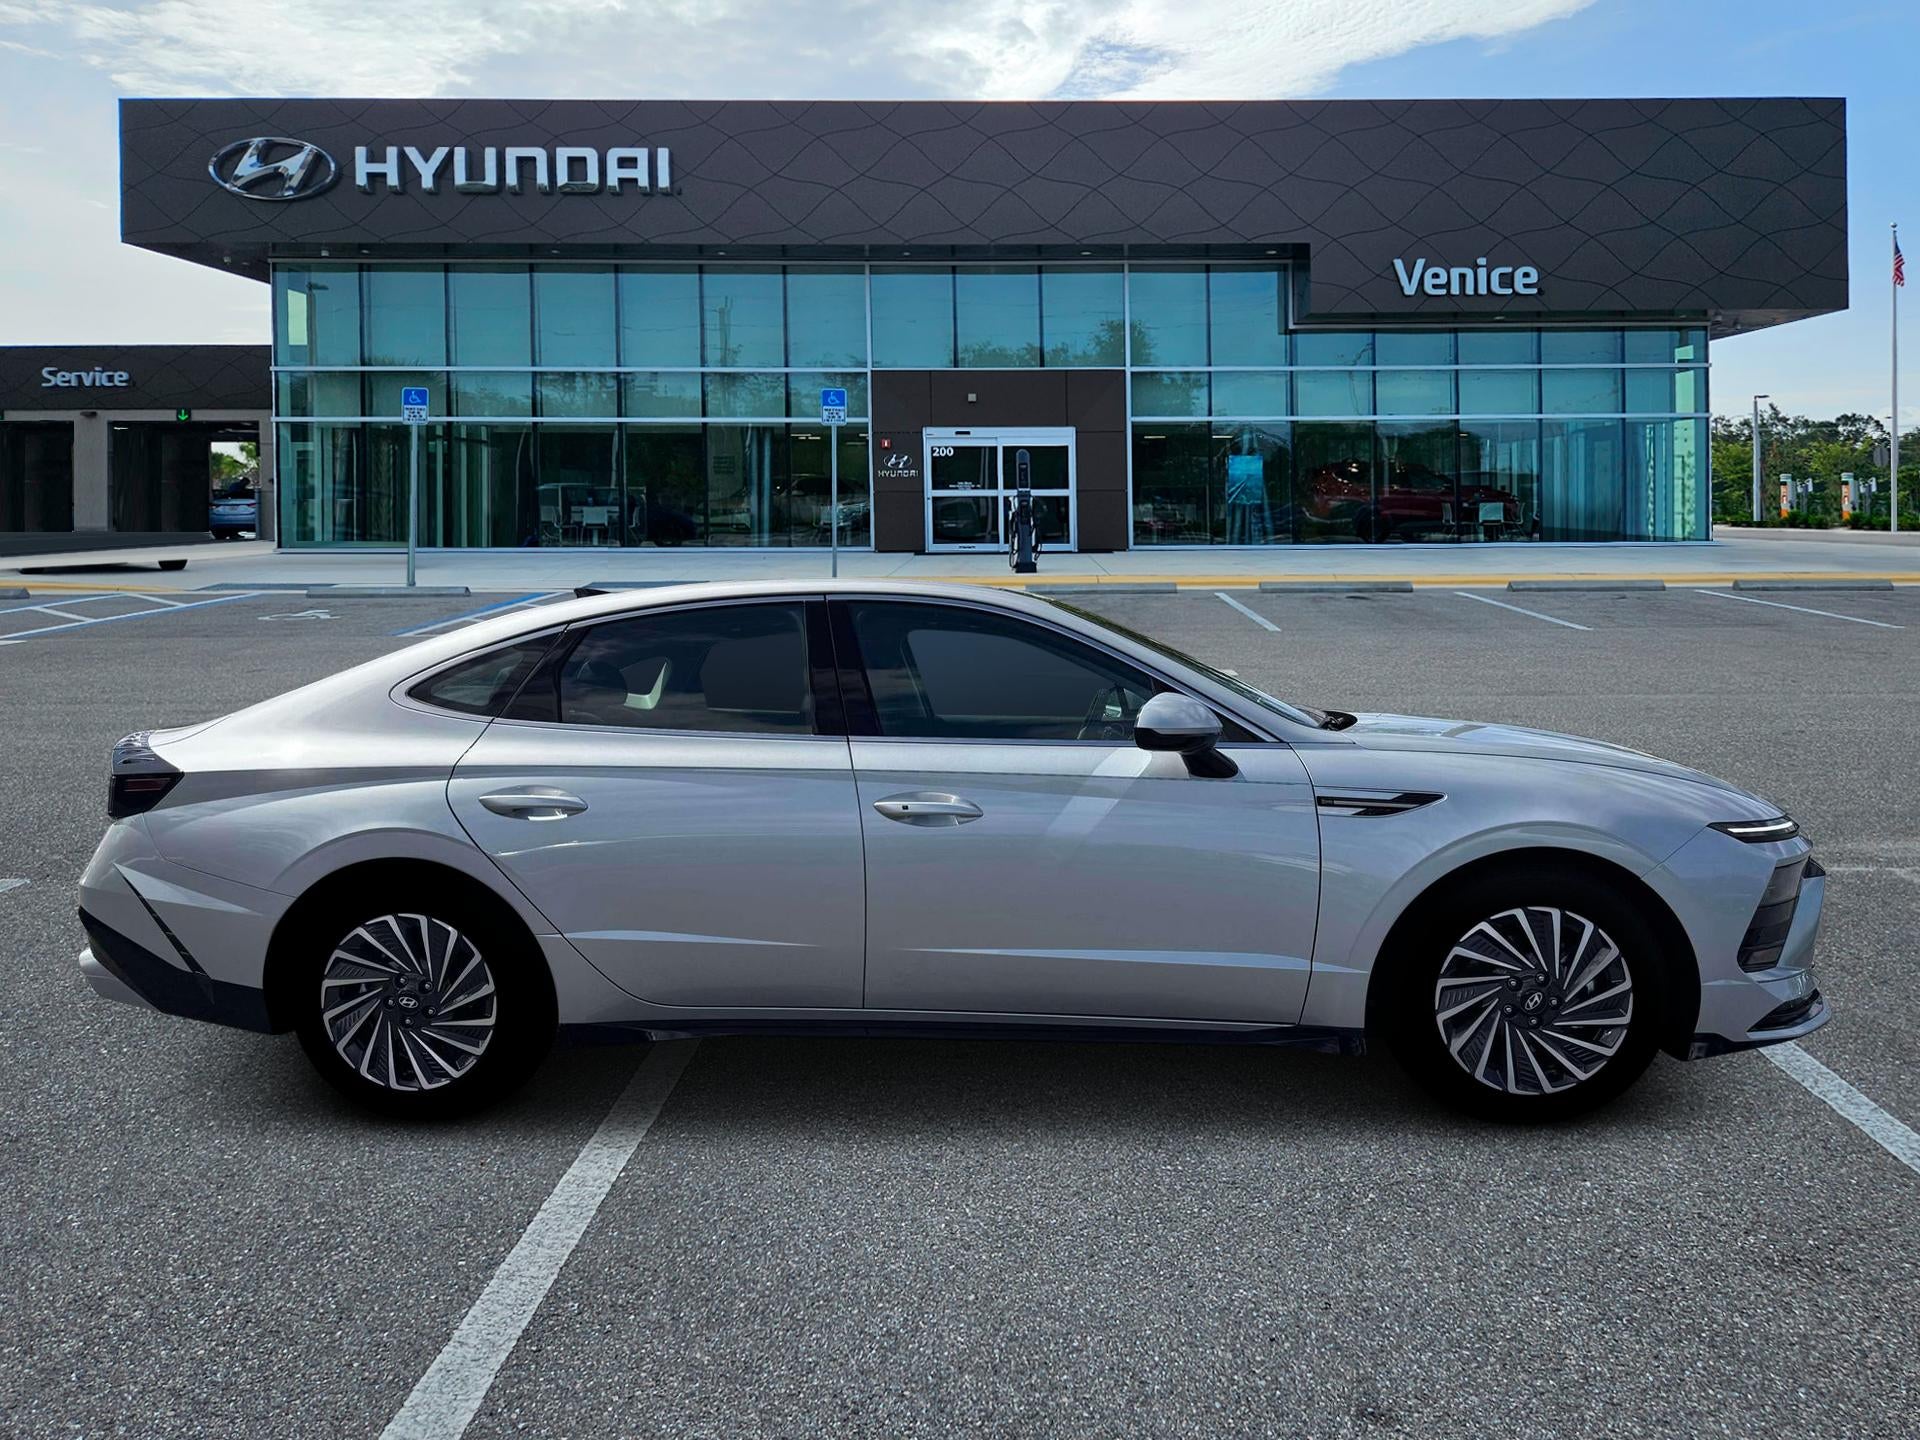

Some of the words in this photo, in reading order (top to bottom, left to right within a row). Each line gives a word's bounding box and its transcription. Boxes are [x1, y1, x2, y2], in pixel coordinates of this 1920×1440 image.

[354, 146, 670, 195] HYUNDAI
[1393, 257, 1539, 296] Venice
[41, 367, 129, 387] Service
[932, 447, 954, 457] 200
[878, 470, 919, 478] HYUNDAI
